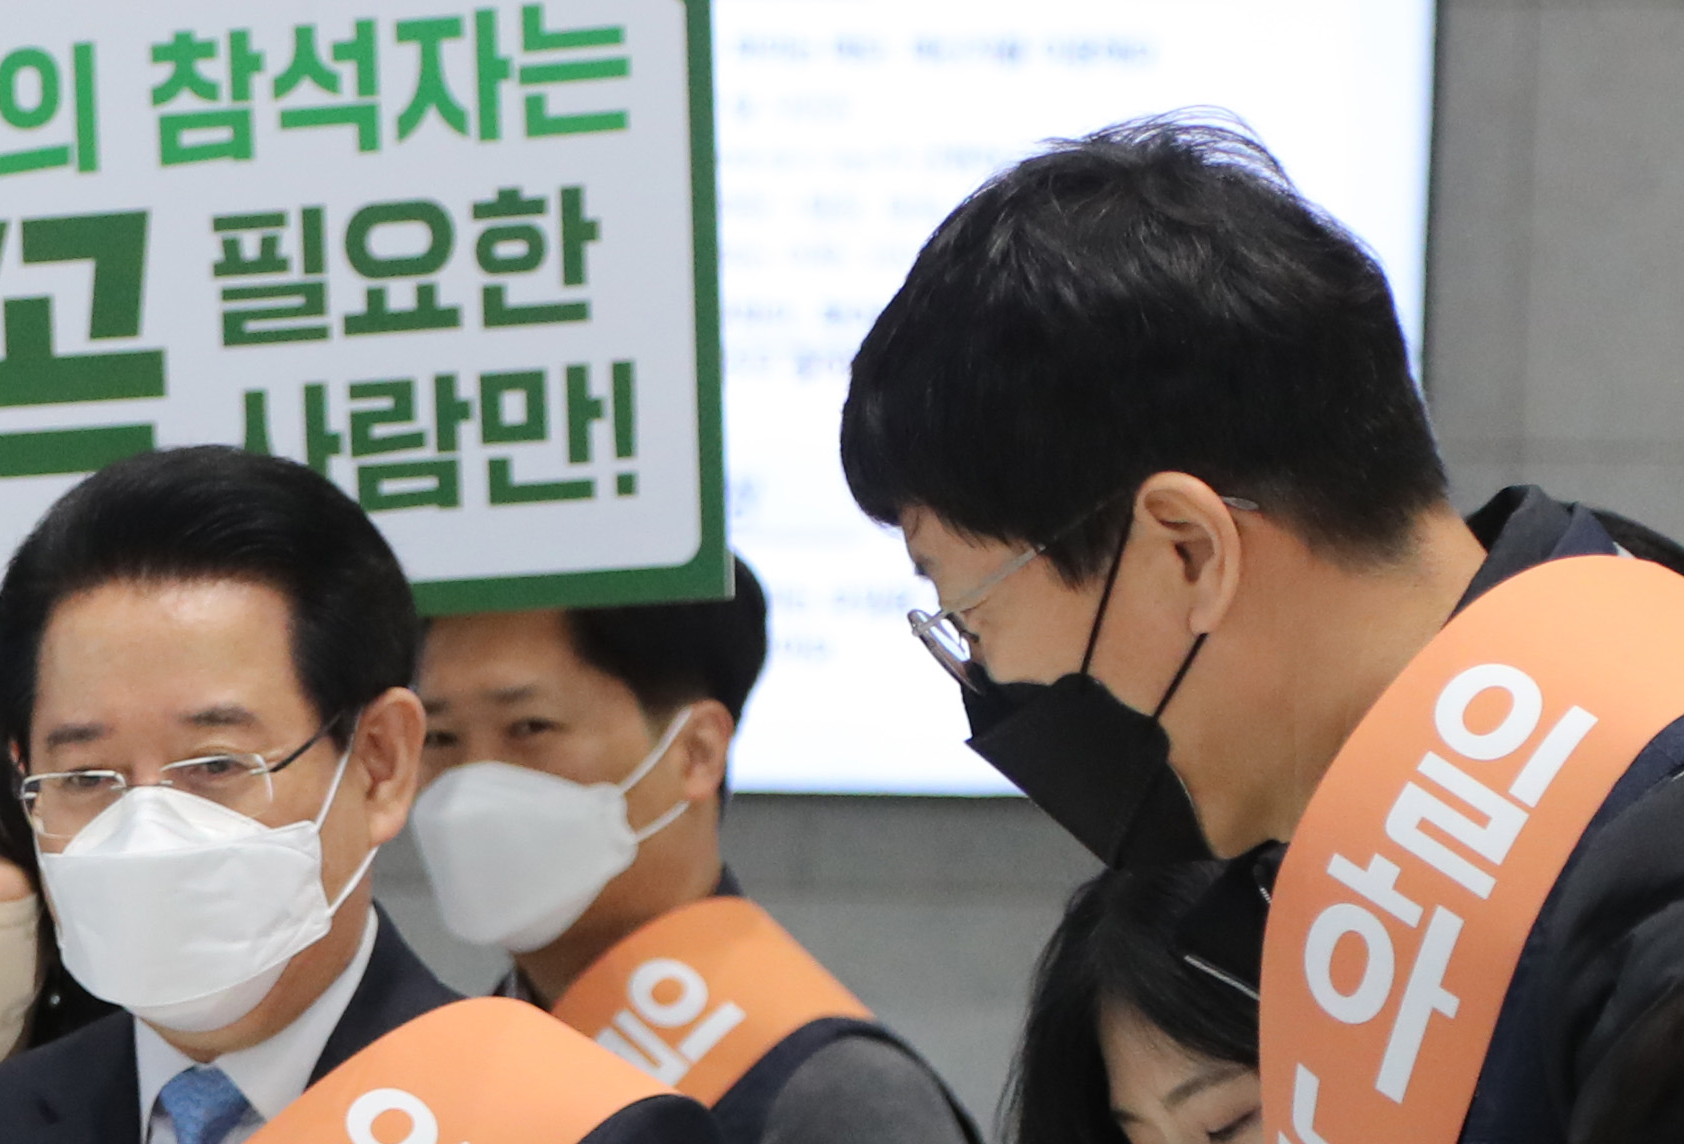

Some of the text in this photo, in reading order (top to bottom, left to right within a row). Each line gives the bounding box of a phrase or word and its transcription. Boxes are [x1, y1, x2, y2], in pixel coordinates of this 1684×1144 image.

[150, 5, 631, 168] 참석자는
[211, 184, 599, 348] 필요한
[238, 361, 638, 514] 사람만!
